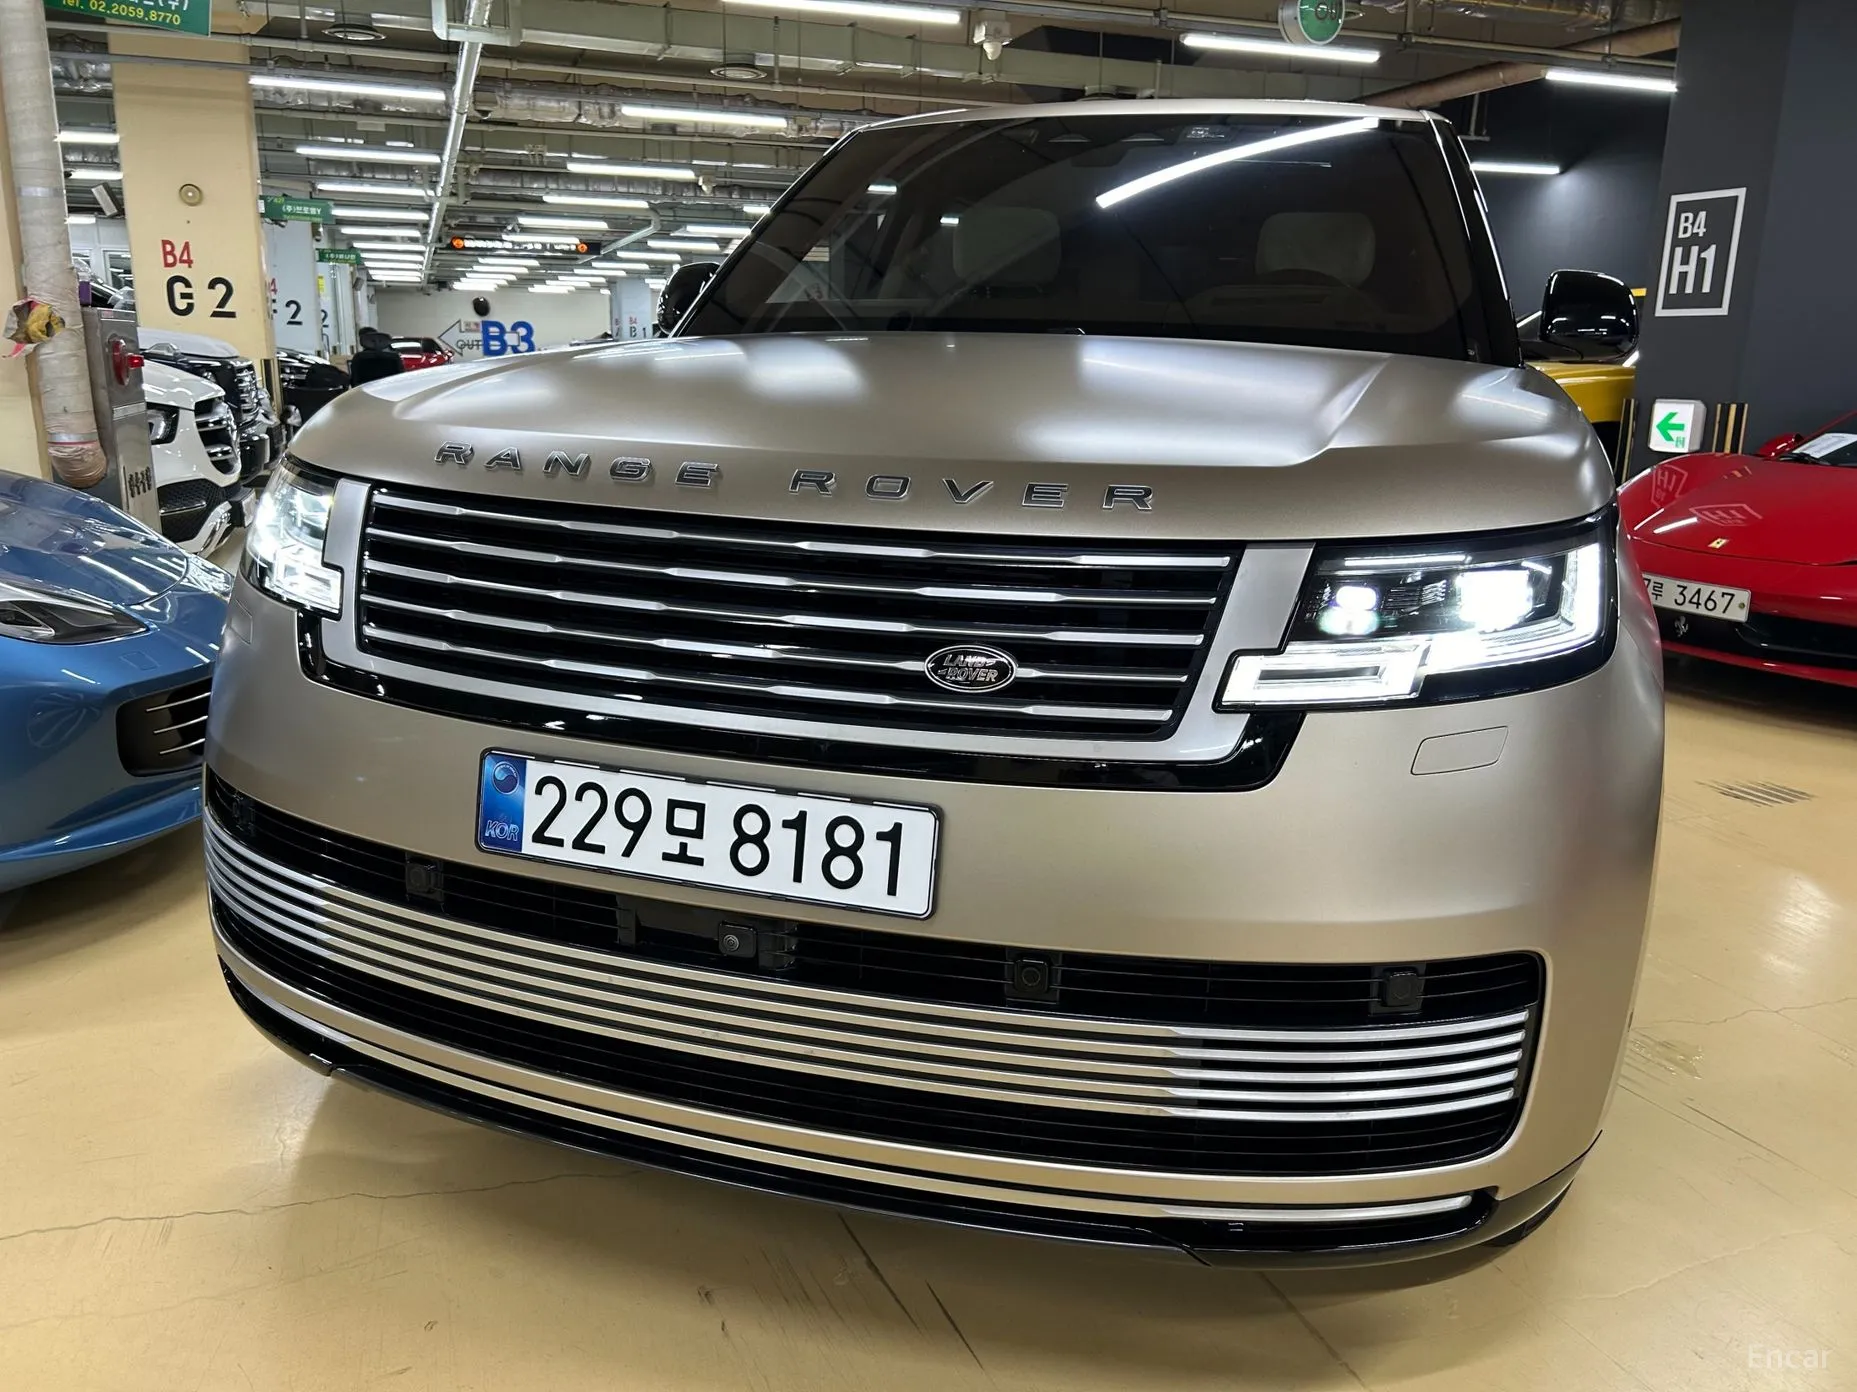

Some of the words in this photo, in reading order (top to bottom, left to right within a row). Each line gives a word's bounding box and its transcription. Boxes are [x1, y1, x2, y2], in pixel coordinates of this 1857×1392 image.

[90, 0, 181, 25] 02.2059.8770
[1678, 211, 1706, 238] B4
[161, 239, 193, 268] B4
[1669, 244, 1716, 294] H1
[482, 320, 535, 356] B3
[434, 441, 720, 488] RANGE
[788, 469, 1153, 510] ROVER
[1674, 584, 1735, 614] 3467
[945, 667, 999, 682] ROVER
[484, 820, 519, 841] KOR
[531, 775, 706, 867] 229모
[729, 803, 903, 896] 8181
